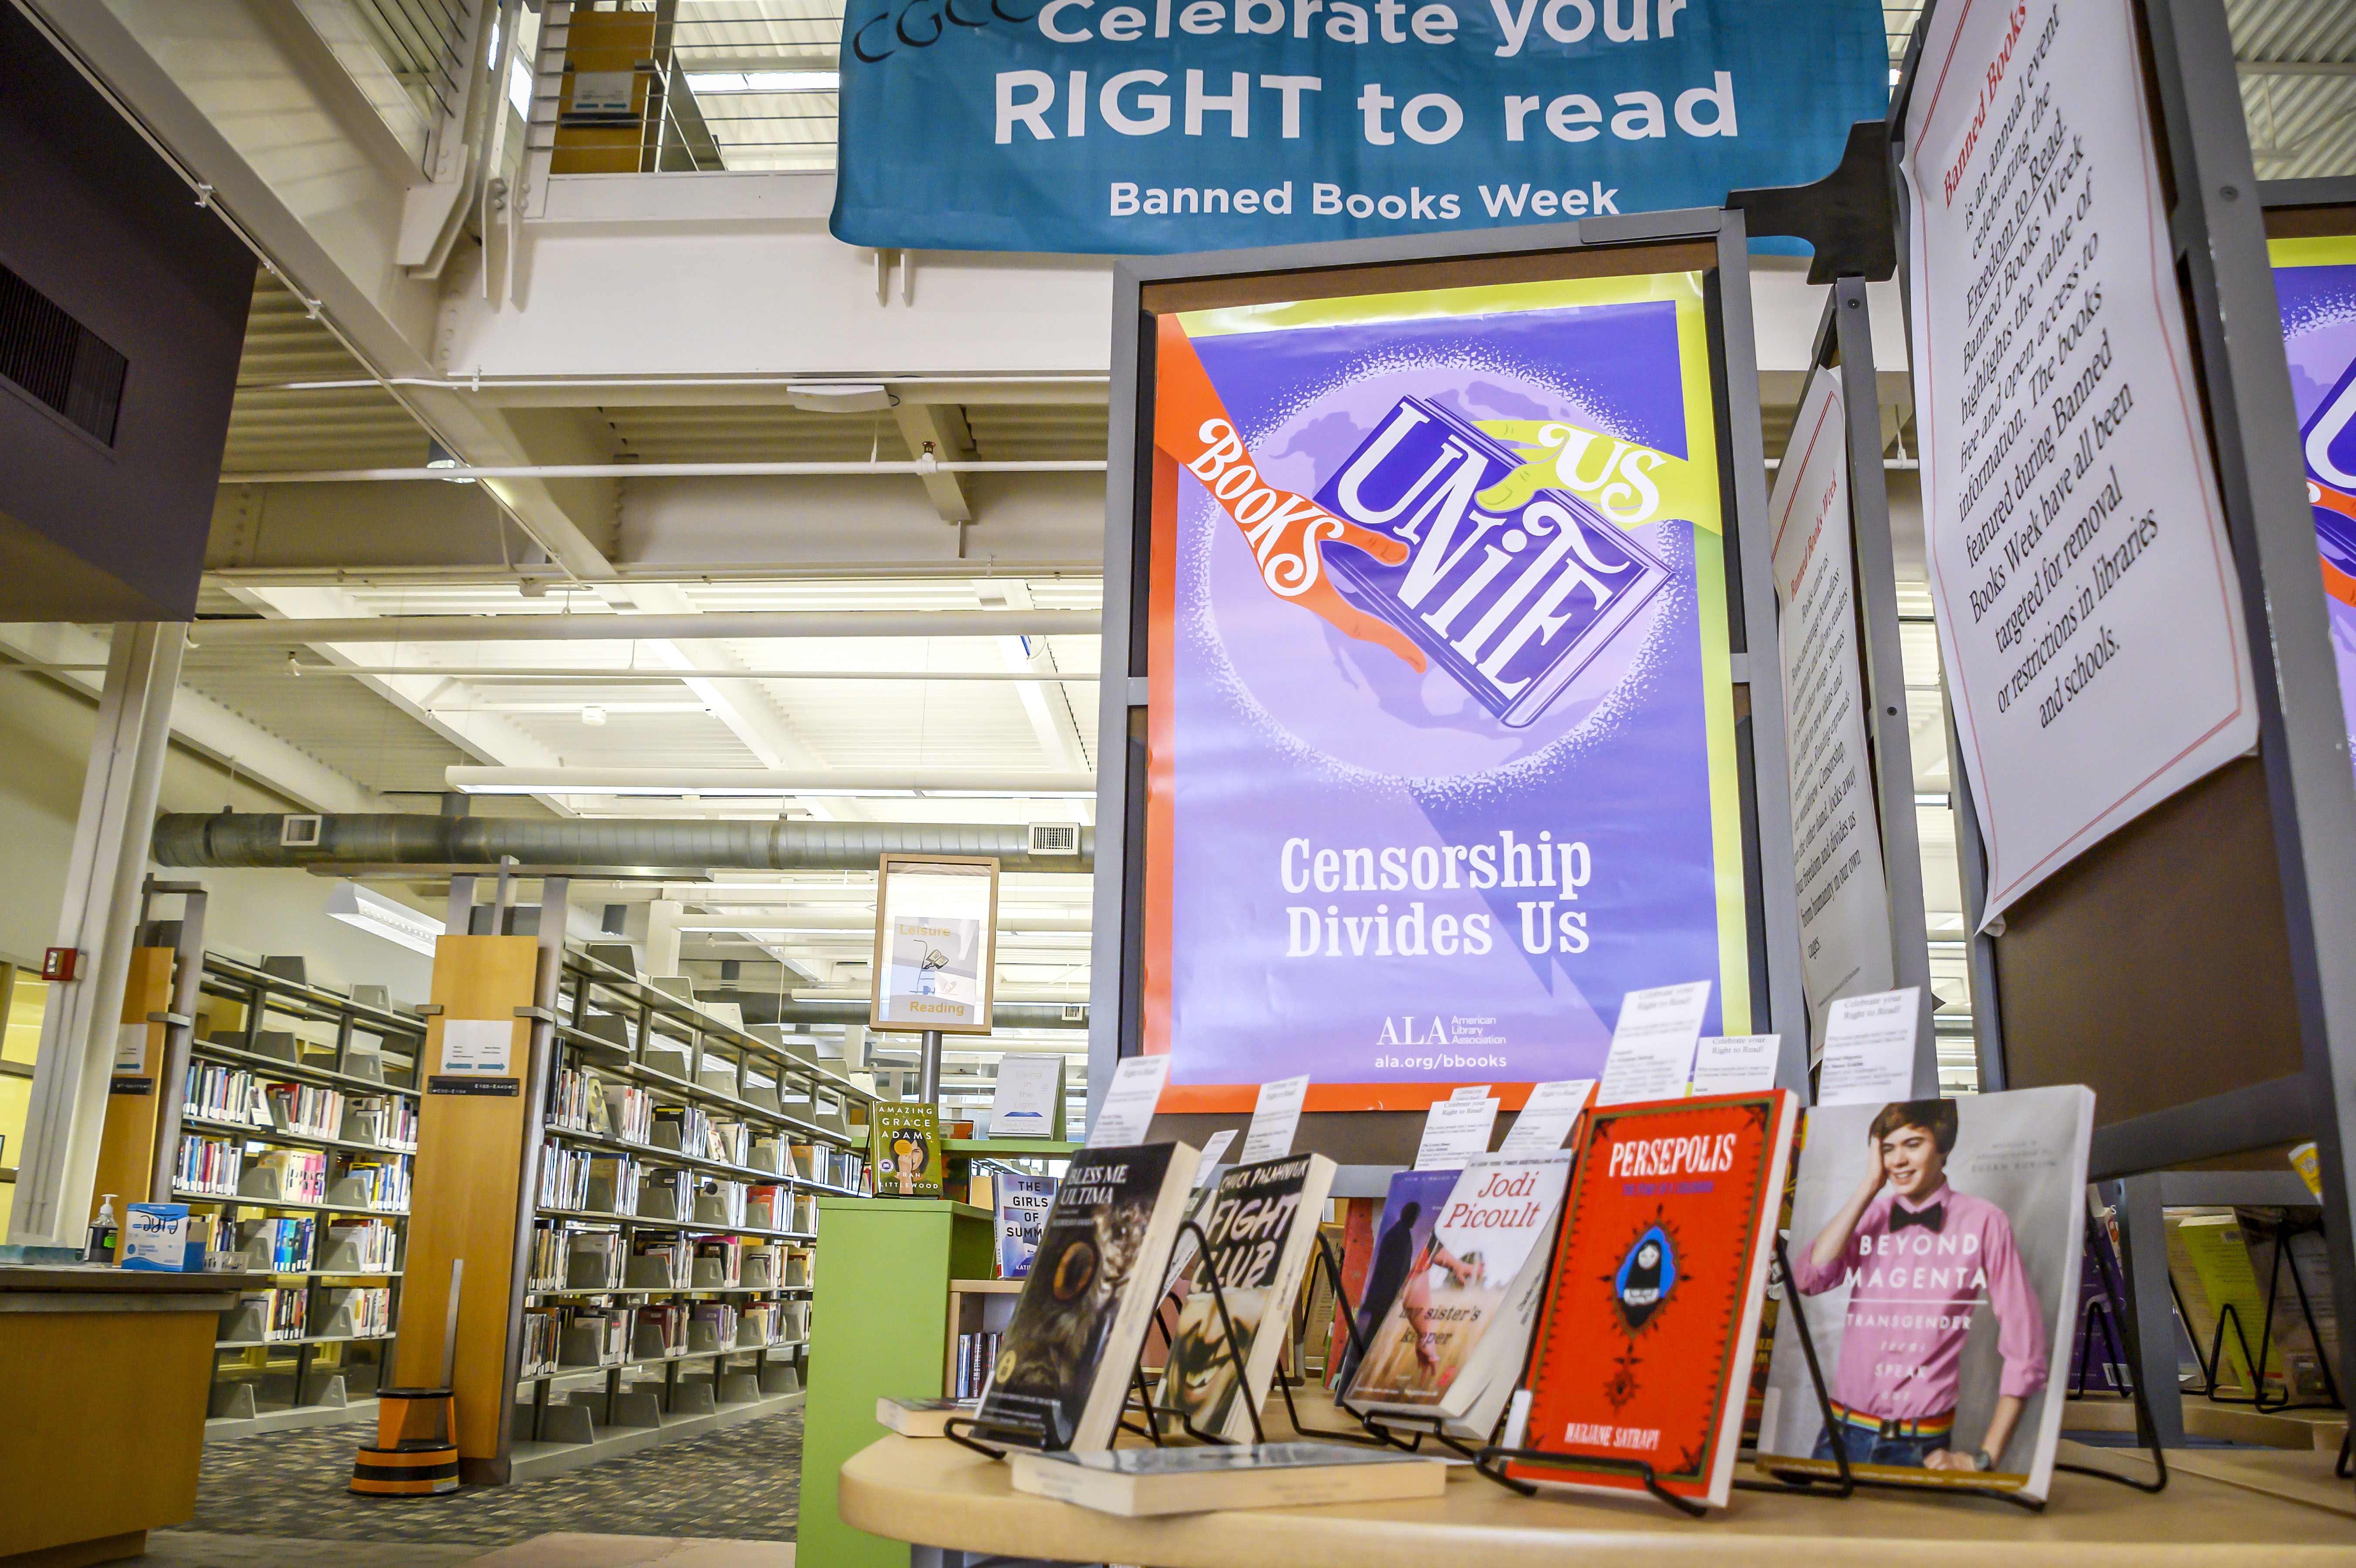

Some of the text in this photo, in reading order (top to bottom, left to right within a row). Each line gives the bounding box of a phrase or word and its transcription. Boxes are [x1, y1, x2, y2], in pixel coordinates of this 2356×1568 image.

[1038, 0, 1687, 57] Celebrate your
[995, 68, 1738, 145] RIGHT to read
[1944, 0, 2026, 212] Banned Books
[1965, 3, 2059, 233] is an annual event
[1973, 82, 2050, 260] celebrating the
[1110, 180, 1620, 220] Banned Books Week
[1966, 107, 2067, 321] Freedom to Read.
[1963, 134, 2084, 376] Banned Books Week
[1961, 166, 2092, 426] highlights the value of
[1960, 232, 2098, 475] free and open access to
[1959, 281, 2102, 523] information. The books
[1966, 327, 2112, 569] featured during Banned
[1186, 418, 1344, 597] BOOKS
[1822, 468, 1836, 518] Week
[1969, 382, 2134, 624] Books Week have all been
[1995, 463, 2123, 653] targeted for removal
[1998, 509, 2158, 713] or restrictions in libraries
[2039, 625, 2120, 728] and schools.
[1828, 784, 1842, 814] locks
[1842, 765, 1855, 796] away
[1280, 830, 1591, 900] Censorship
[1803, 855, 1821, 889] freedom
[1821, 836, 1830, 868] and
[1830, 816, 1848, 855] divides
[1848, 811, 1856, 832] us
[1801, 849, 1861, 928] from humanity in our own
[900, 924, 951, 936] Leisure
[1286, 901, 1589, 957] Divides Us
[910, 1001, 964, 1016] Reading
[1451, 1015, 1496, 1024] American
[1376, 1016, 1450, 1045] ALA
[1451, 1035, 1506, 1044] Association
[1452, 1025, 1483, 1036] Library
[1375, 1053, 1507, 1070] ala.org/bbooks
[879, 1106, 932, 1115] AMAZING
[882, 1118, 931, 1127] GRACE
[881, 1130, 931, 1139] ADAMS
[1609, 1133, 1737, 1177] PERSEPOLIS
[1018, 1181, 1041, 1192] THE
[1060, 1186, 1114, 1205] ULTIMA
[1067, 1166, 1104, 1185] BLESS
[1478, 1172, 1540, 1198] Jodi
[1013, 1196, 1048, 1207] GIRLS
[1024, 1212, 1039, 1222] OF
[1205, 1191, 1303, 1245] FIGHT
[1444, 1202, 1540, 1228] Picoult
[1007, 1227, 1043, 1238] SUMM
[1859, 1234, 1979, 1256] BEYOND
[1190, 1241, 1277, 1294] CLUB
[1843, 1267, 1988, 1289] MAGENTA
[1424, 1306, 1481, 1321] sister's
[1847, 1314, 1973, 1330] TRANSGENDER
[1875, 1363, 1928, 1379] SPEAK
[1564, 1422, 1661, 1450] MARJANE SATRAPI
